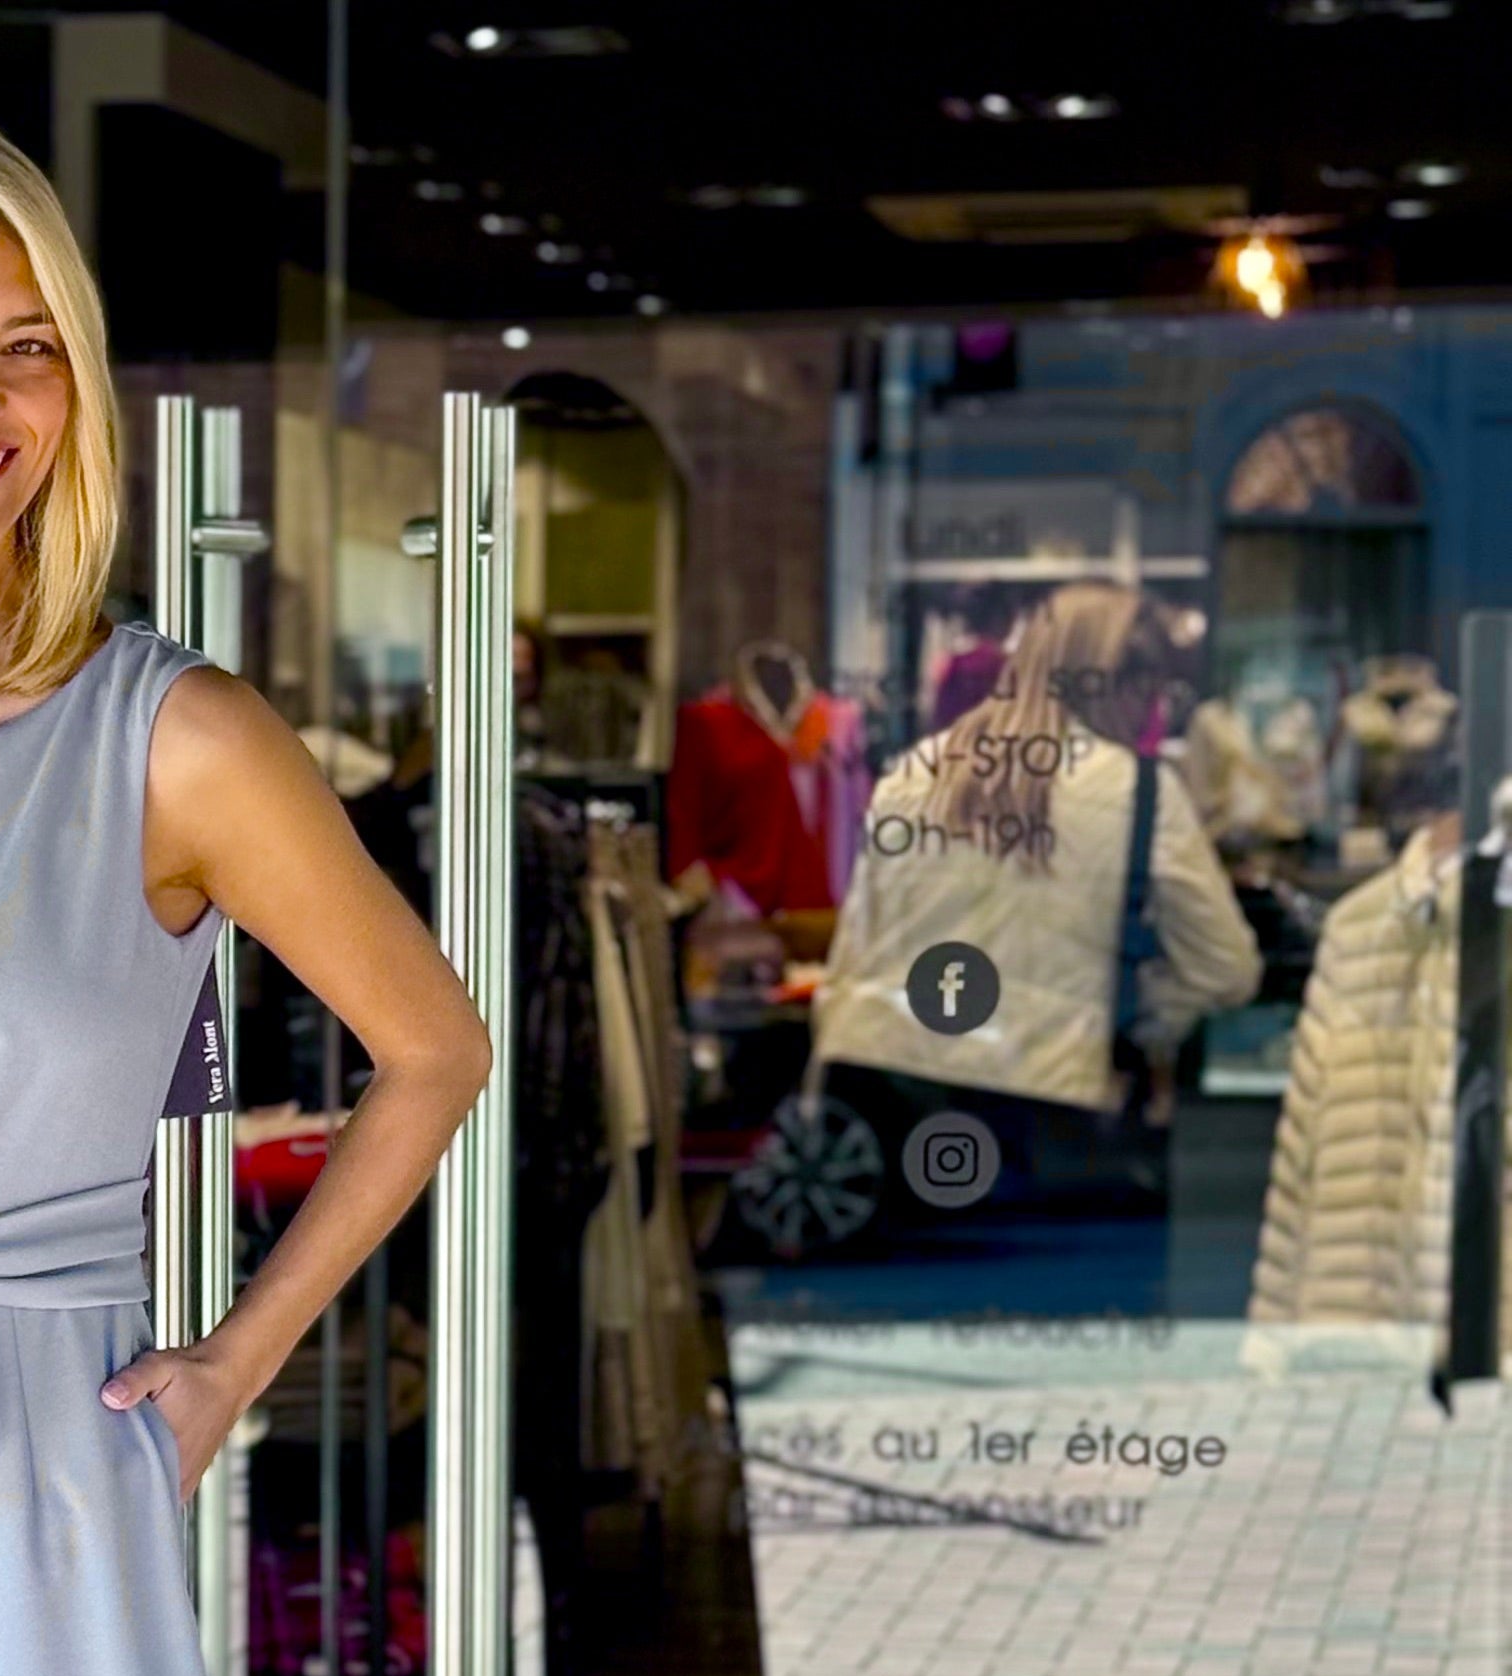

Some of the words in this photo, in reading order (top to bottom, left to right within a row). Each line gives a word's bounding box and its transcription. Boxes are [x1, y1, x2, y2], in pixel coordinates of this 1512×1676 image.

[203, 1019, 220, 1064] Mont
[209, 1067, 224, 1104] Vera
[871, 1423, 940, 1463] au
[1065, 1417, 1228, 1477] étage
